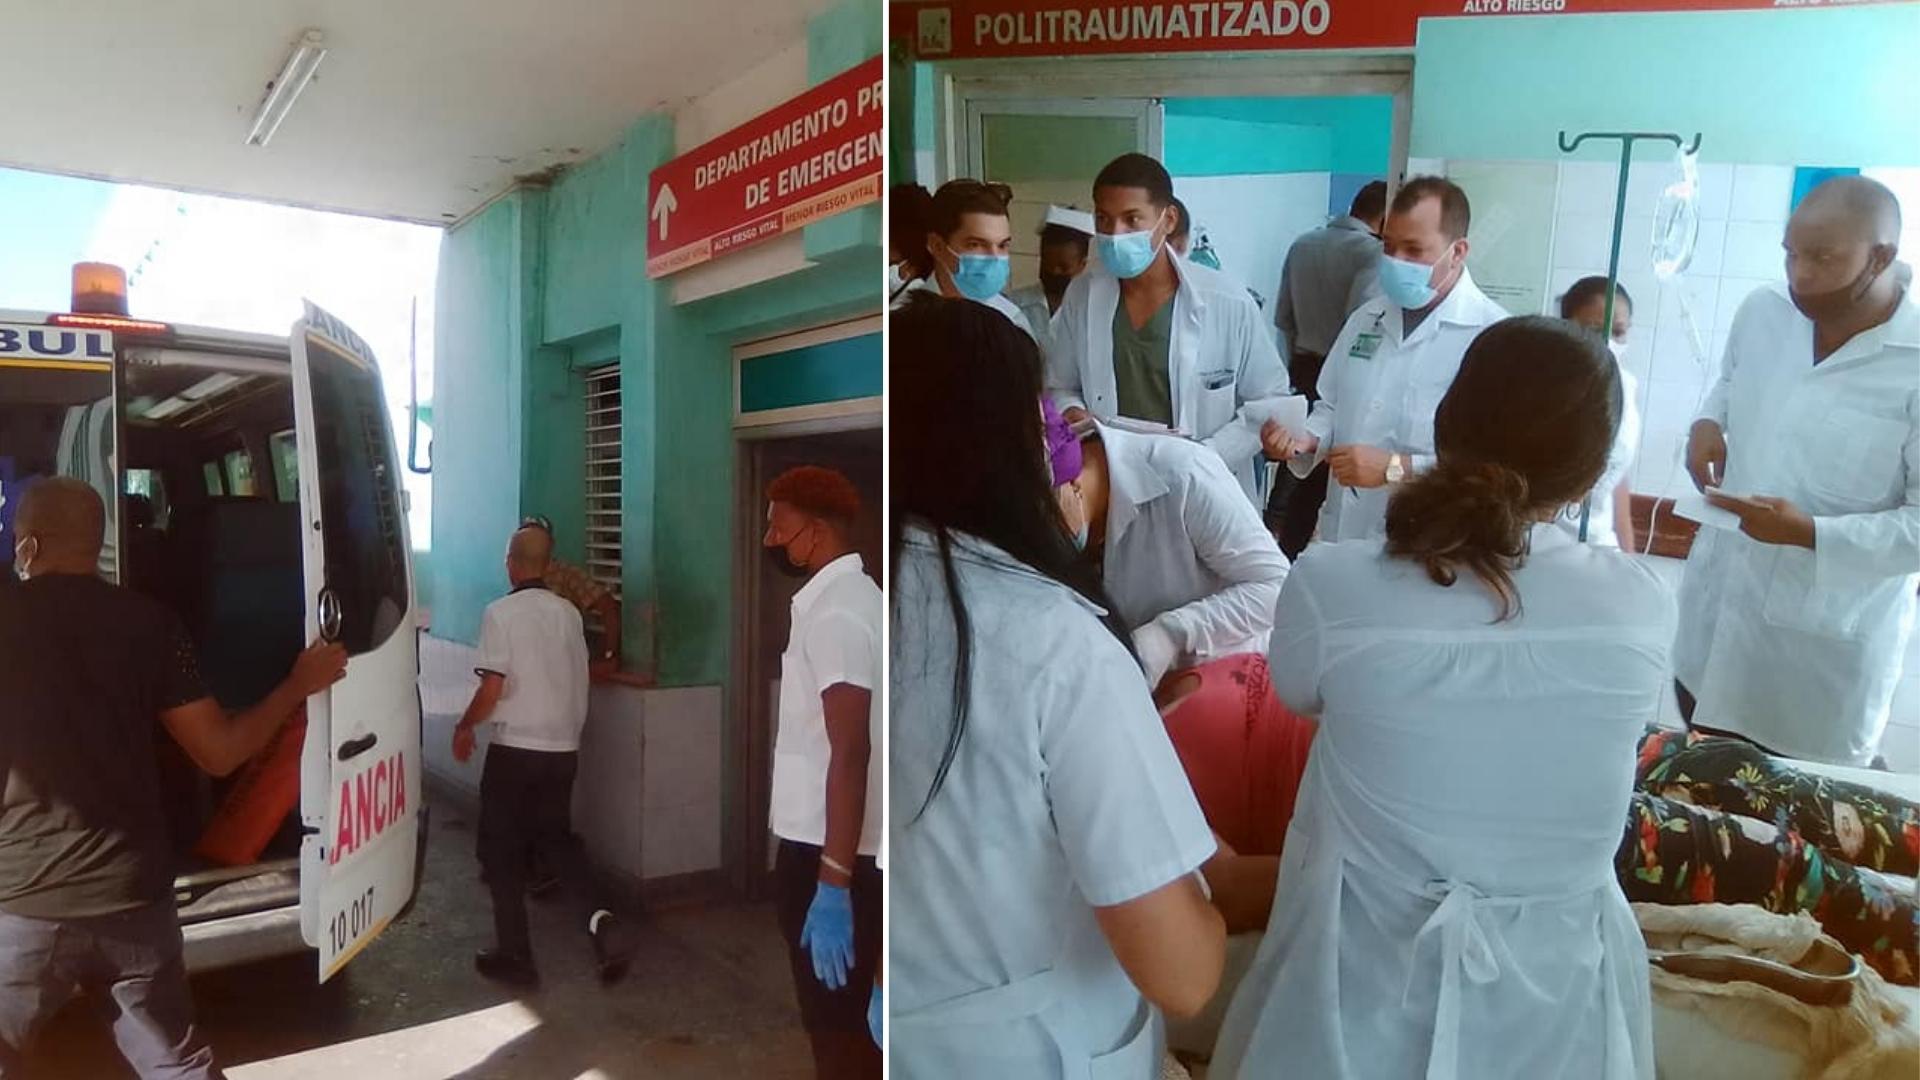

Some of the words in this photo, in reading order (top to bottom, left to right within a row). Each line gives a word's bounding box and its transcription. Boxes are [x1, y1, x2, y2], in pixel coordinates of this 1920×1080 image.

[974, 0, 1331, 45] POLITRAUMATIZADO
[1463, 0, 1503, 13] ALTO
[1506, 0, 1567, 12] RIESGO
[694, 98, 849, 191] DEPARTAMENTO
[745, 177, 771, 210] DE
[777, 129, 883, 197] EMERGEN
[816, 194, 848, 214] RIESGO
[330, 752, 405, 865] ANCIA
[329, 909, 347, 956] 10
[351, 886, 375, 939] 017
